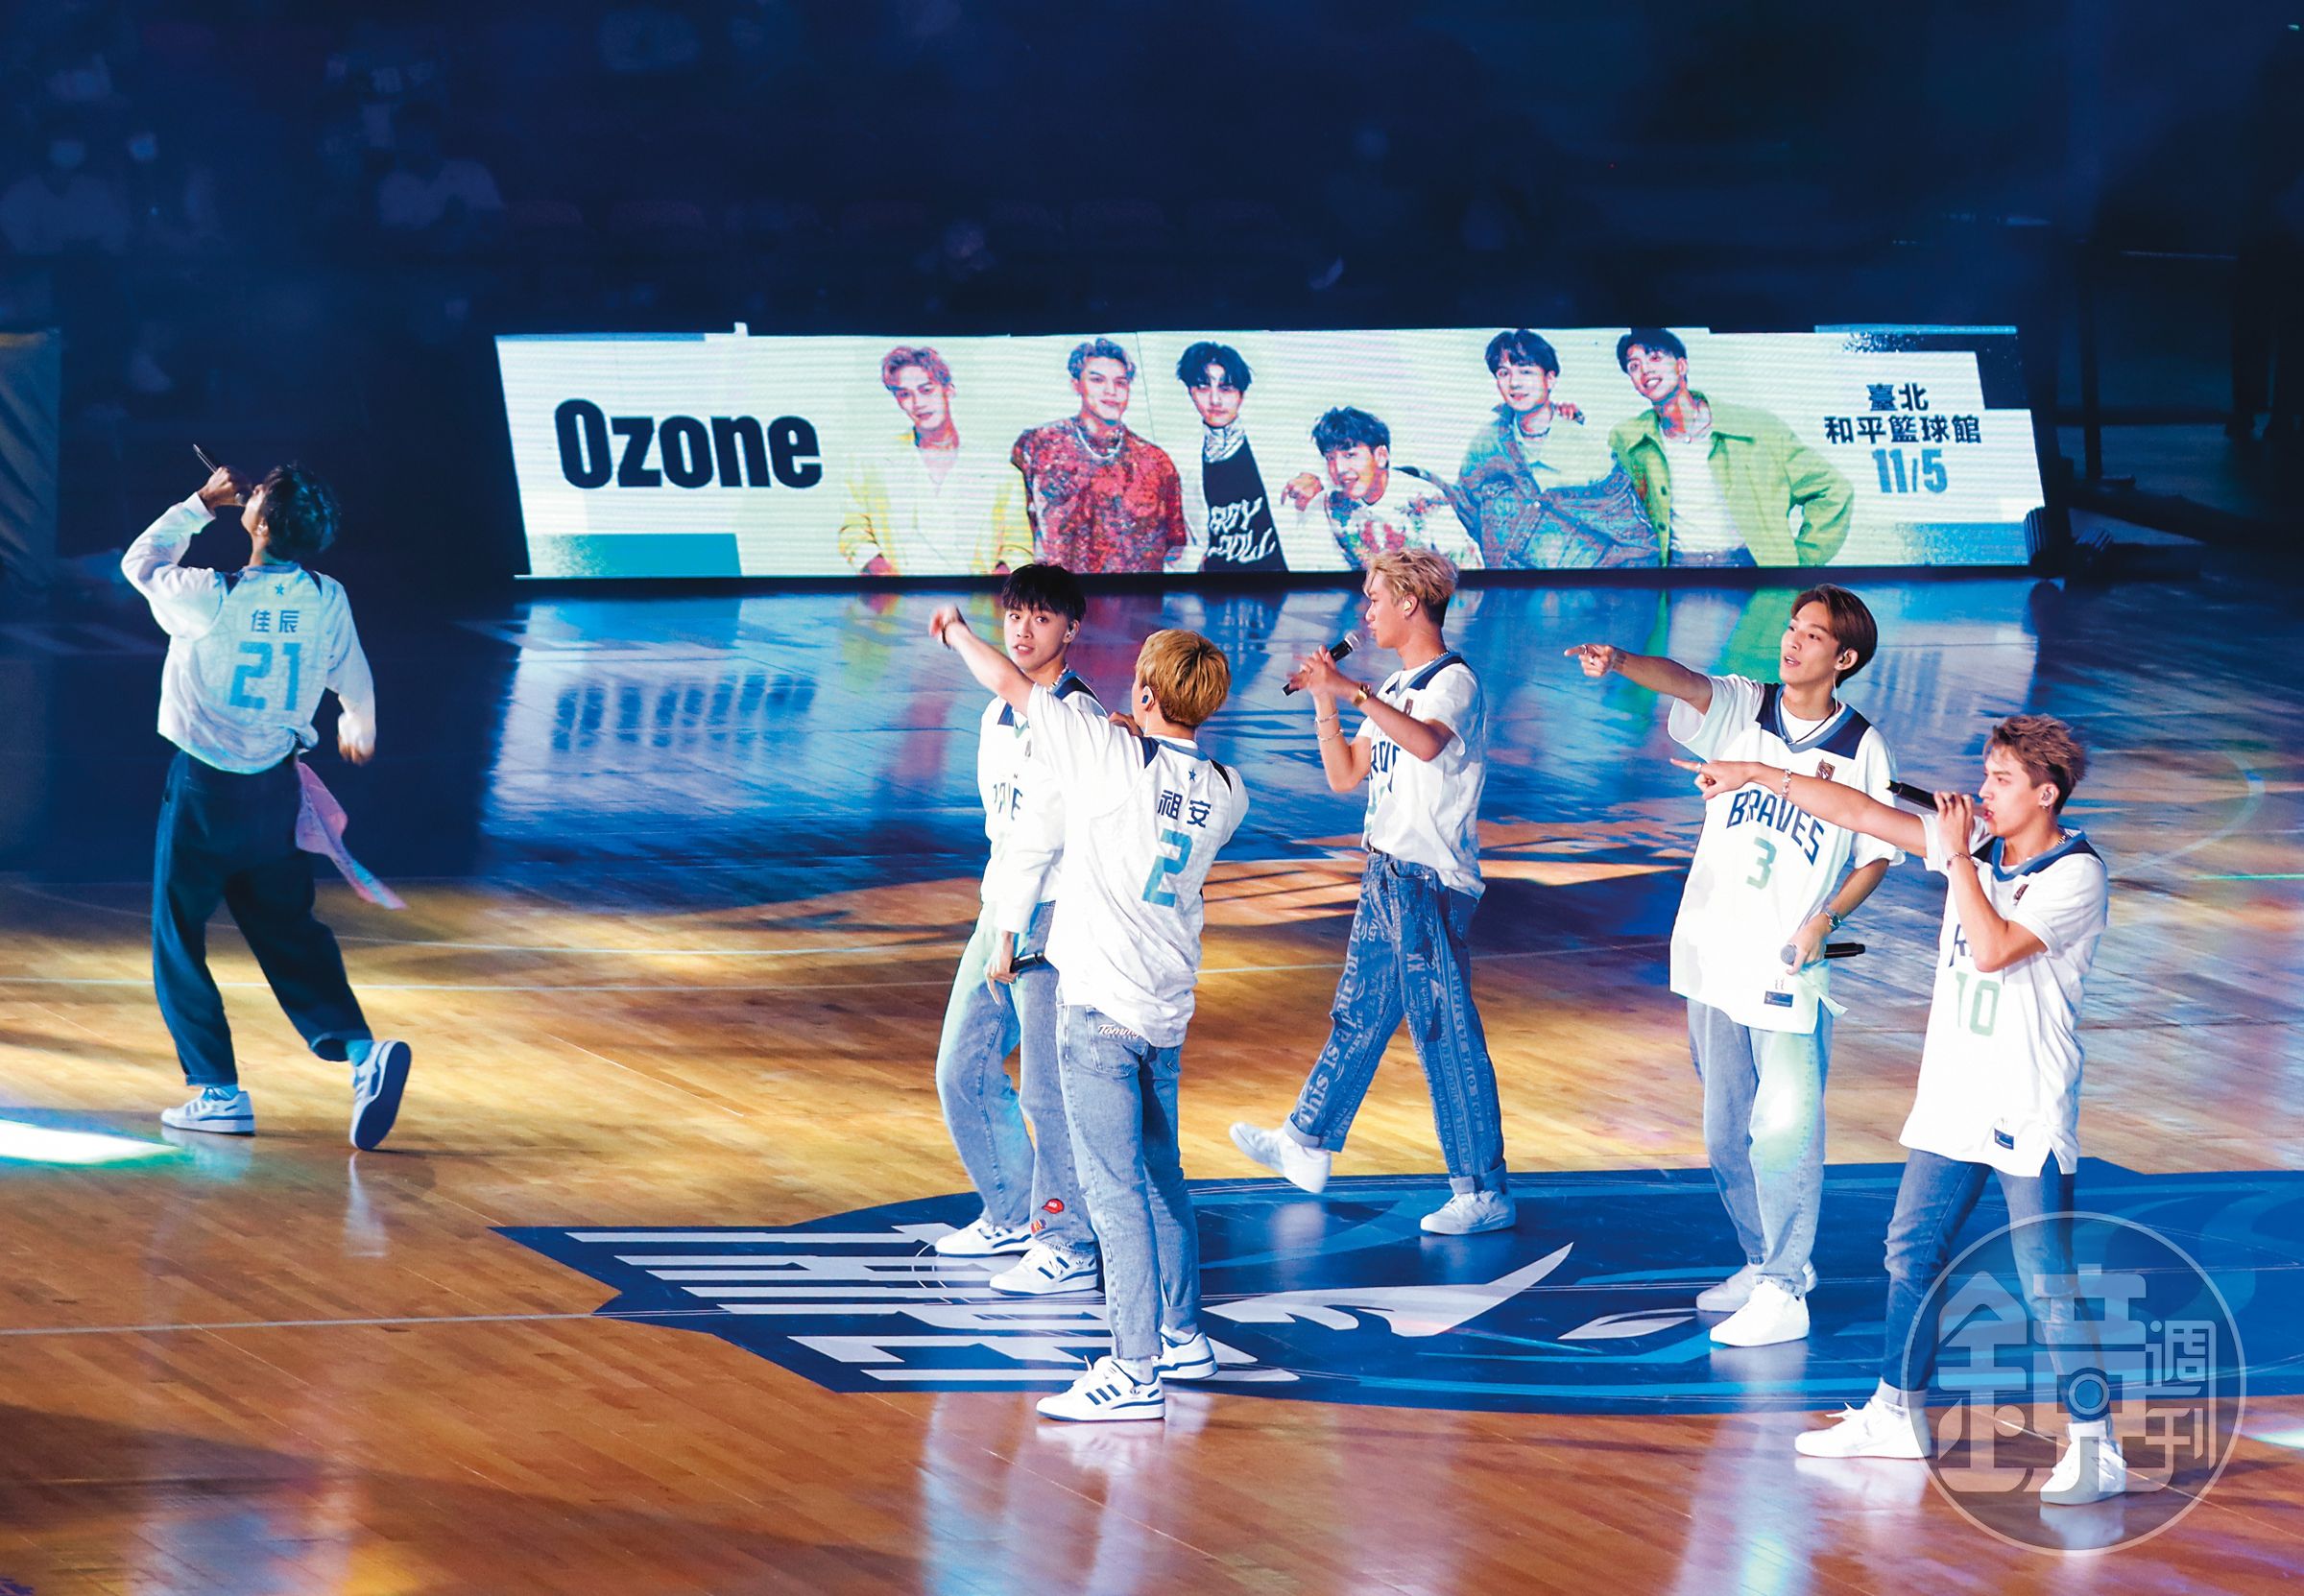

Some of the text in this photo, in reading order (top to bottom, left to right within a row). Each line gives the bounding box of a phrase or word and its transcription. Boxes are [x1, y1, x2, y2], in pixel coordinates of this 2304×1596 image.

[1866, 383, 1929, 411] 臺北
[554, 398, 823, 489] Ozone
[1824, 415, 1981, 444] 和平籃球館
[1872, 448, 1948, 493] 11/5
[251, 609, 300, 633] 佳辰
[229, 641, 301, 711] 21
[1157, 789, 1212, 828] 祖安
[1726, 789, 1824, 867] BRAVES
[1141, 828, 1193, 908] 2
[1746, 836, 1777, 890] 3
[1407, 953, 1426, 973] XX
[1956, 971, 2001, 1036] 10
[1298, 1074, 1331, 1125] This
[1323, 1043, 1341, 1070] is
[1335, 1028, 1354, 1044] a
